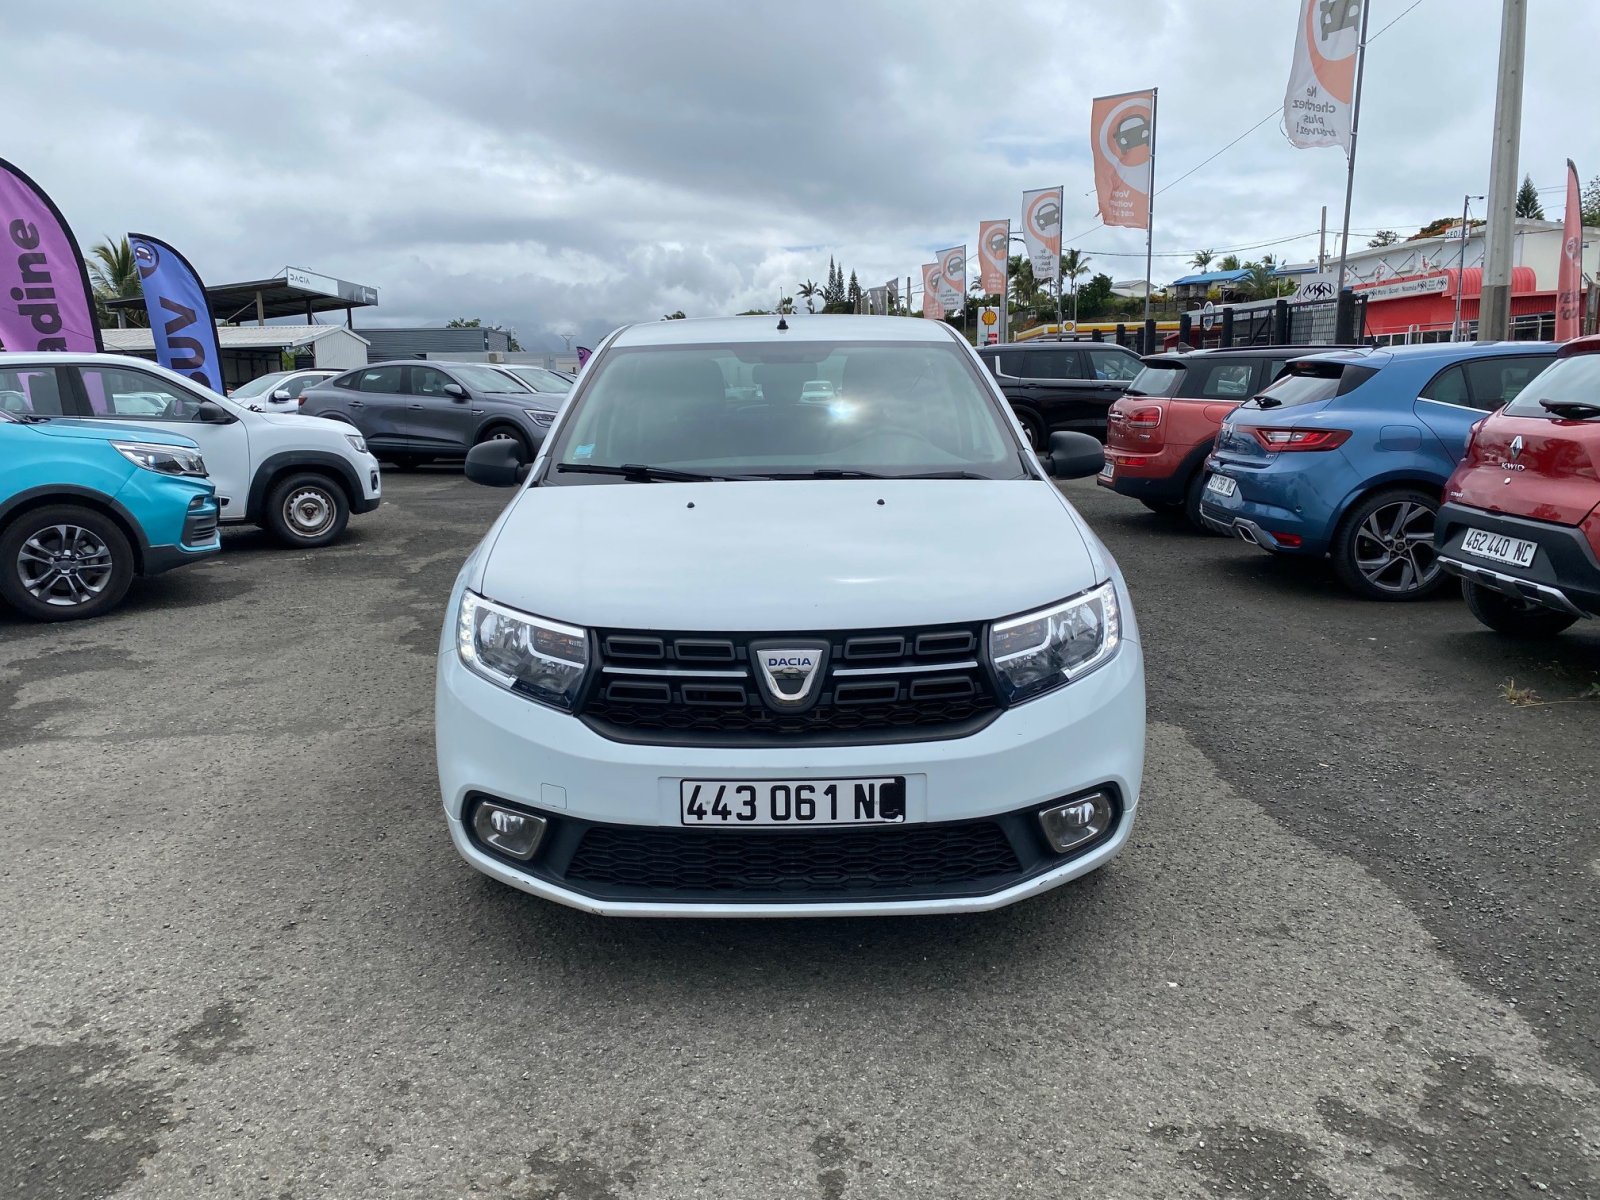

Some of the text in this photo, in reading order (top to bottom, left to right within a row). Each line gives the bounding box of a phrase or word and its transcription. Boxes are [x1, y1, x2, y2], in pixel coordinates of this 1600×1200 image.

[159, 296, 212, 389] UV
[1501, 462, 1526, 472] KWID
[1465, 531, 1489, 552] 462
[1487, 537, 1511, 557] 440
[1513, 541, 1533, 563] NC
[768, 657, 812, 667] DACIA
[687, 784, 757, 821] 443
[770, 783, 838, 821] 061
